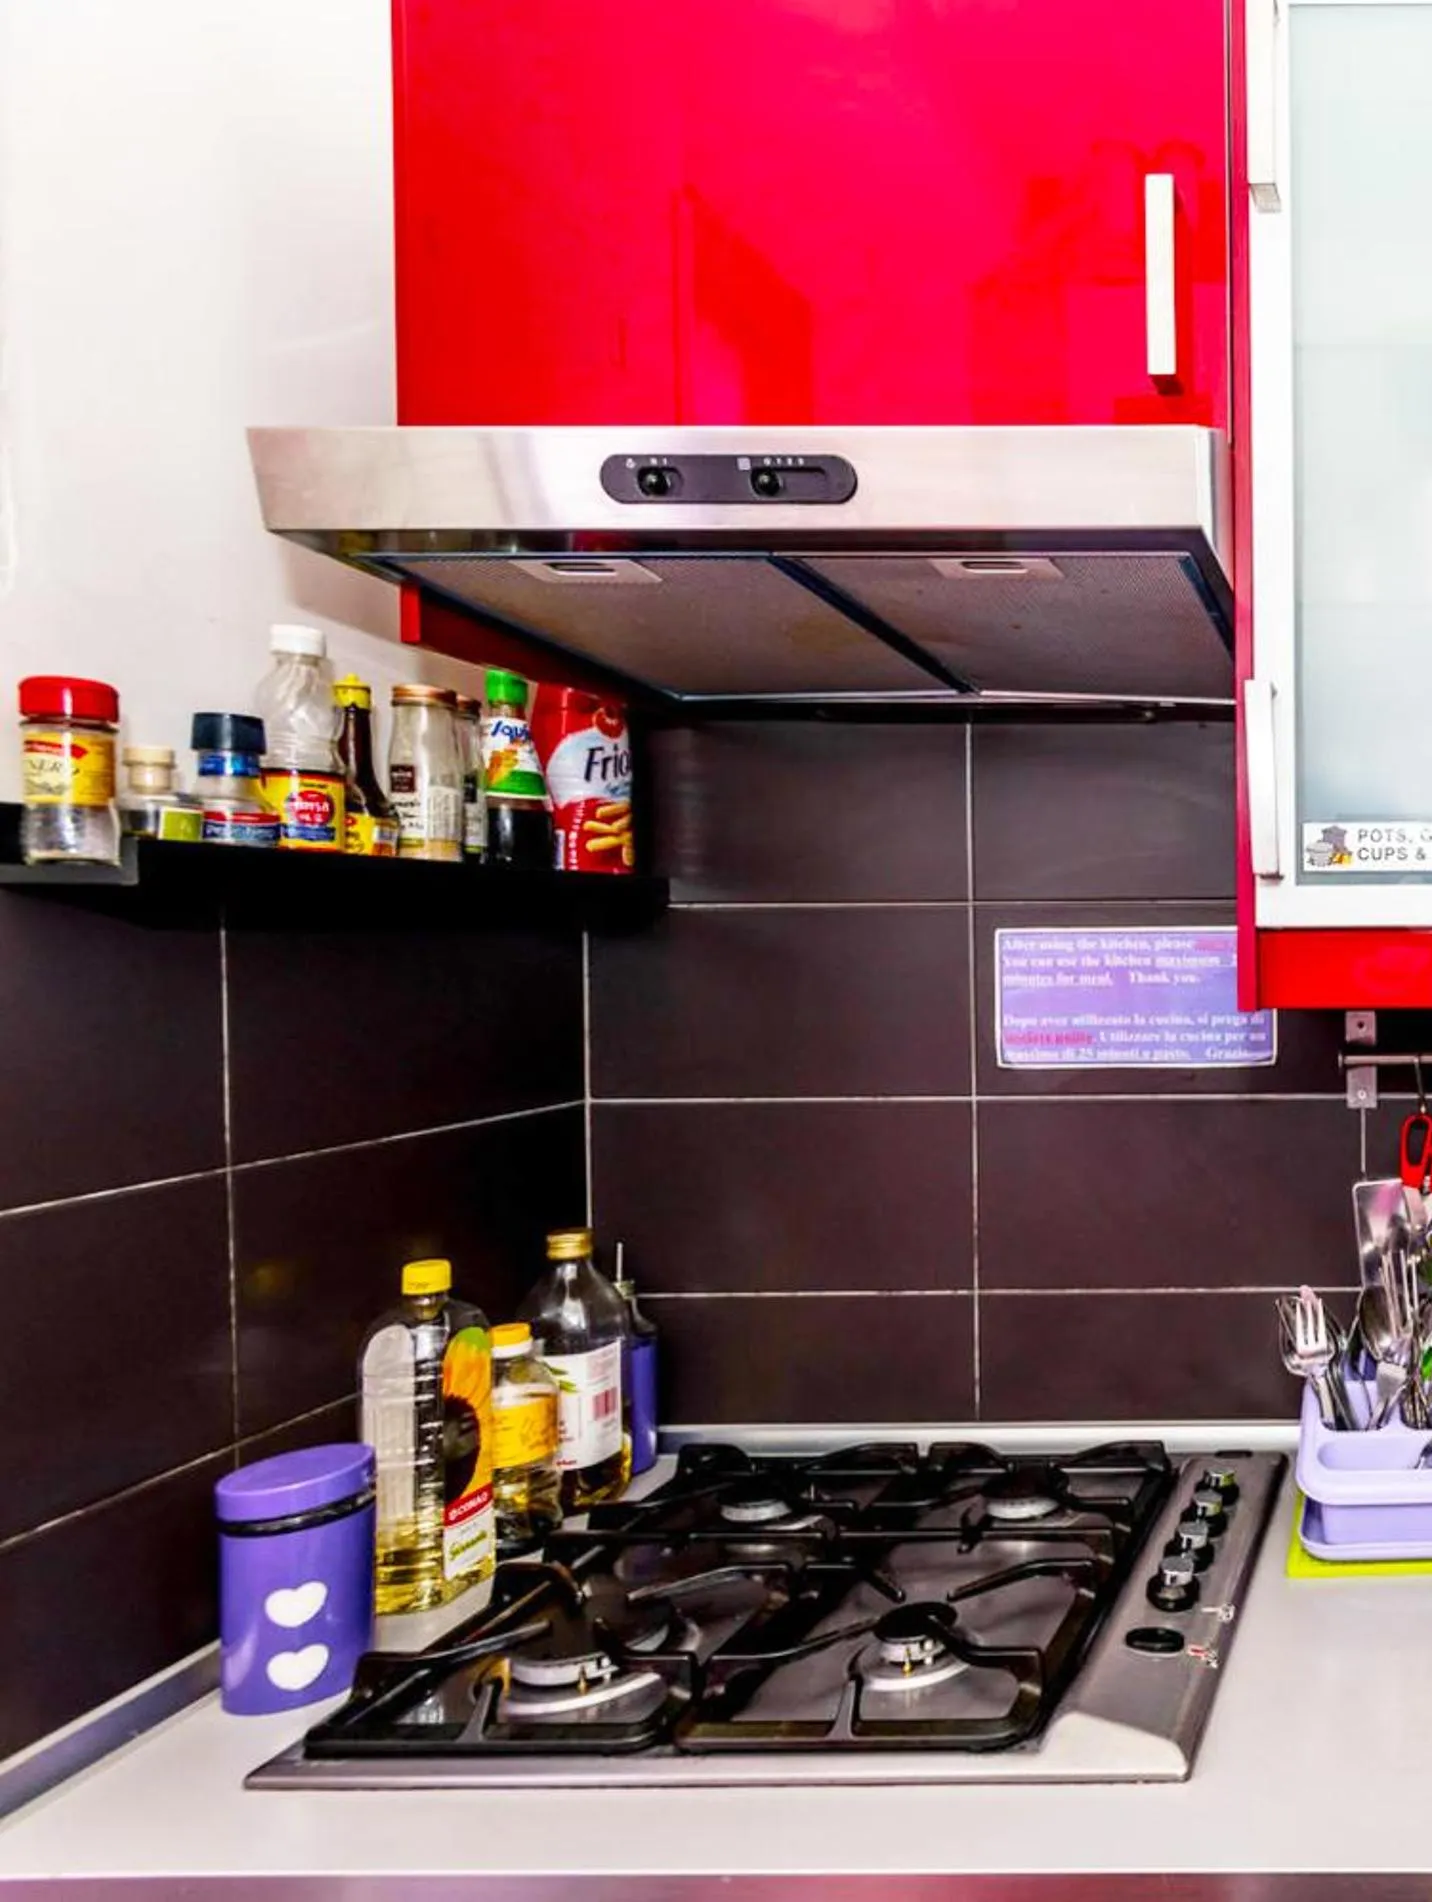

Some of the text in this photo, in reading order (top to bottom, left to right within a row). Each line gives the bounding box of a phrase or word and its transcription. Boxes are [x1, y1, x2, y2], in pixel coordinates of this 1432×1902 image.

[1357, 828, 1414, 844] POTS,
[1357, 847, 1408, 861] CUPS
[1415, 847, 1427, 861] &
